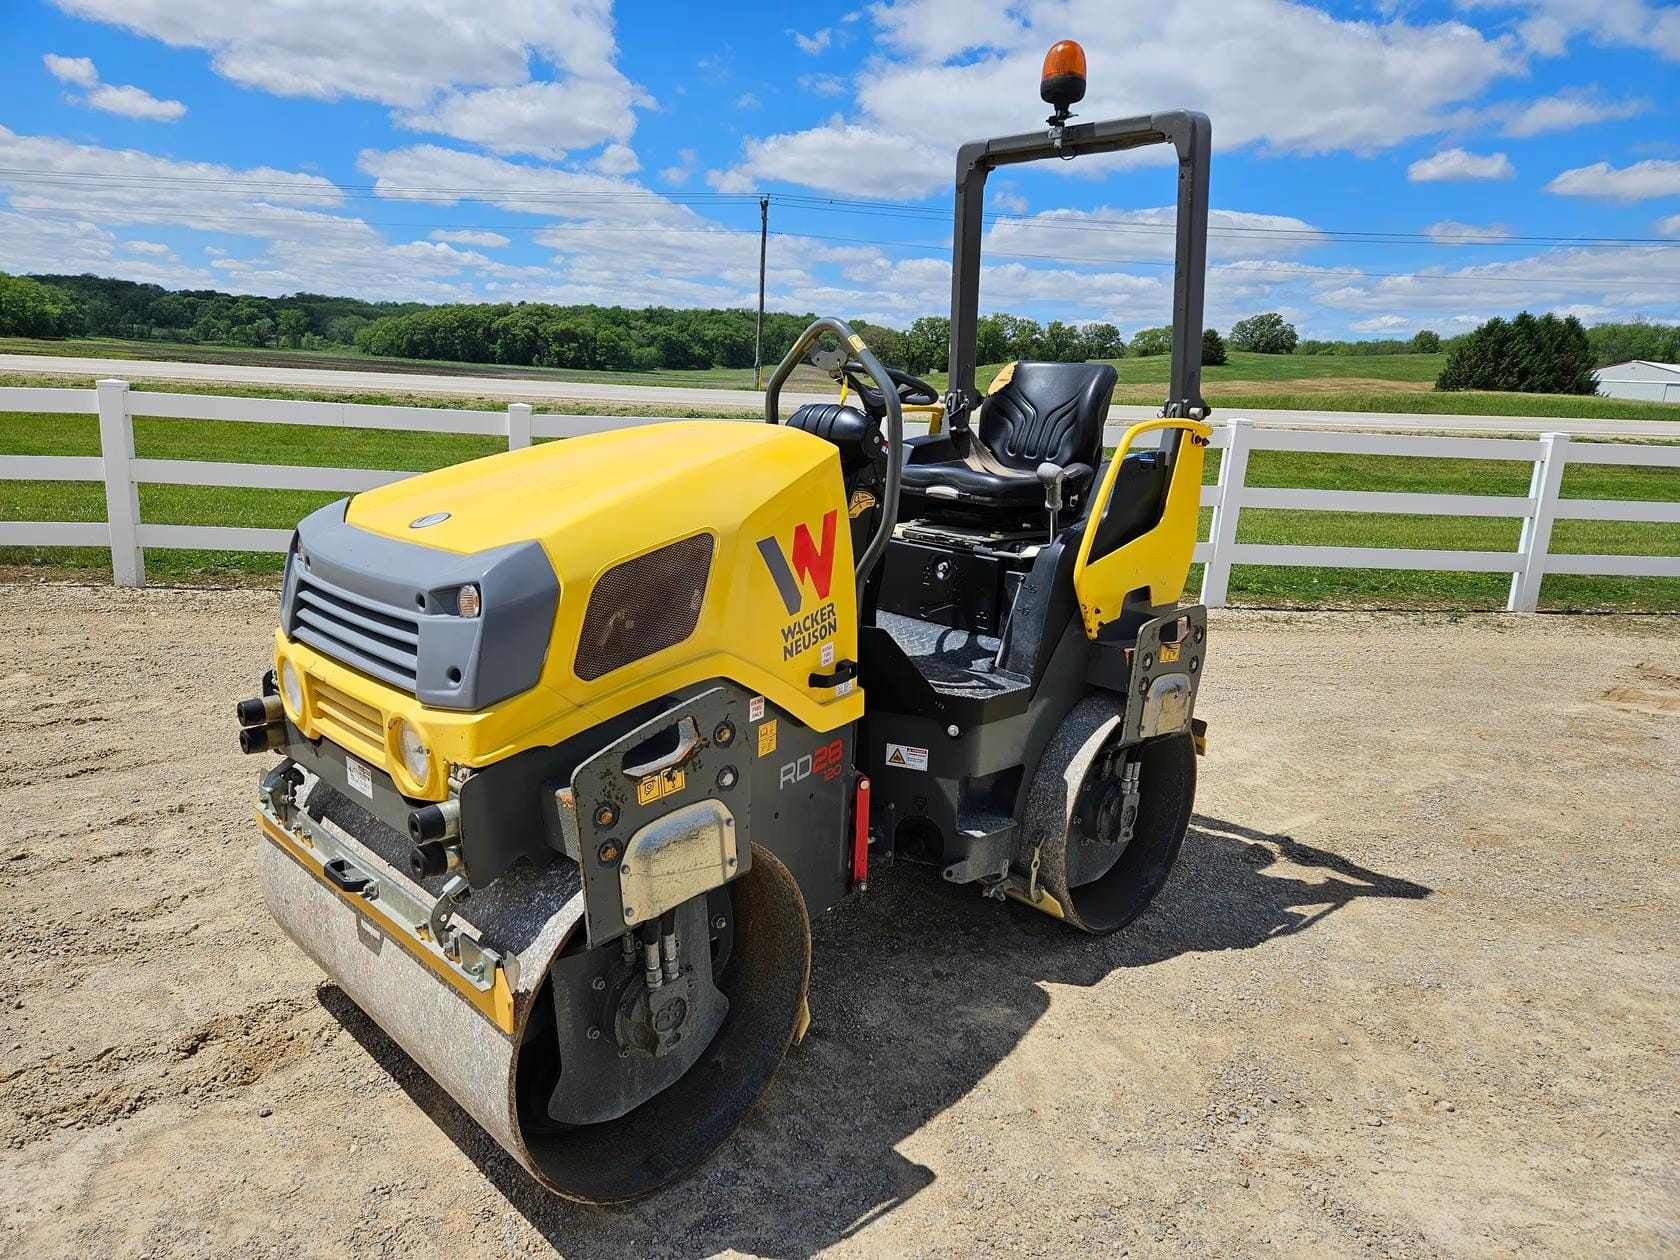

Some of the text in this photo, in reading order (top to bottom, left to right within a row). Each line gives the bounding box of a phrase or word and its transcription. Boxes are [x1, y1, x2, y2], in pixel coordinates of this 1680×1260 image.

[781, 602, 836, 643] WACKER
[784, 617, 837, 662] NEUSON
[780, 739, 843, 790] RD28
